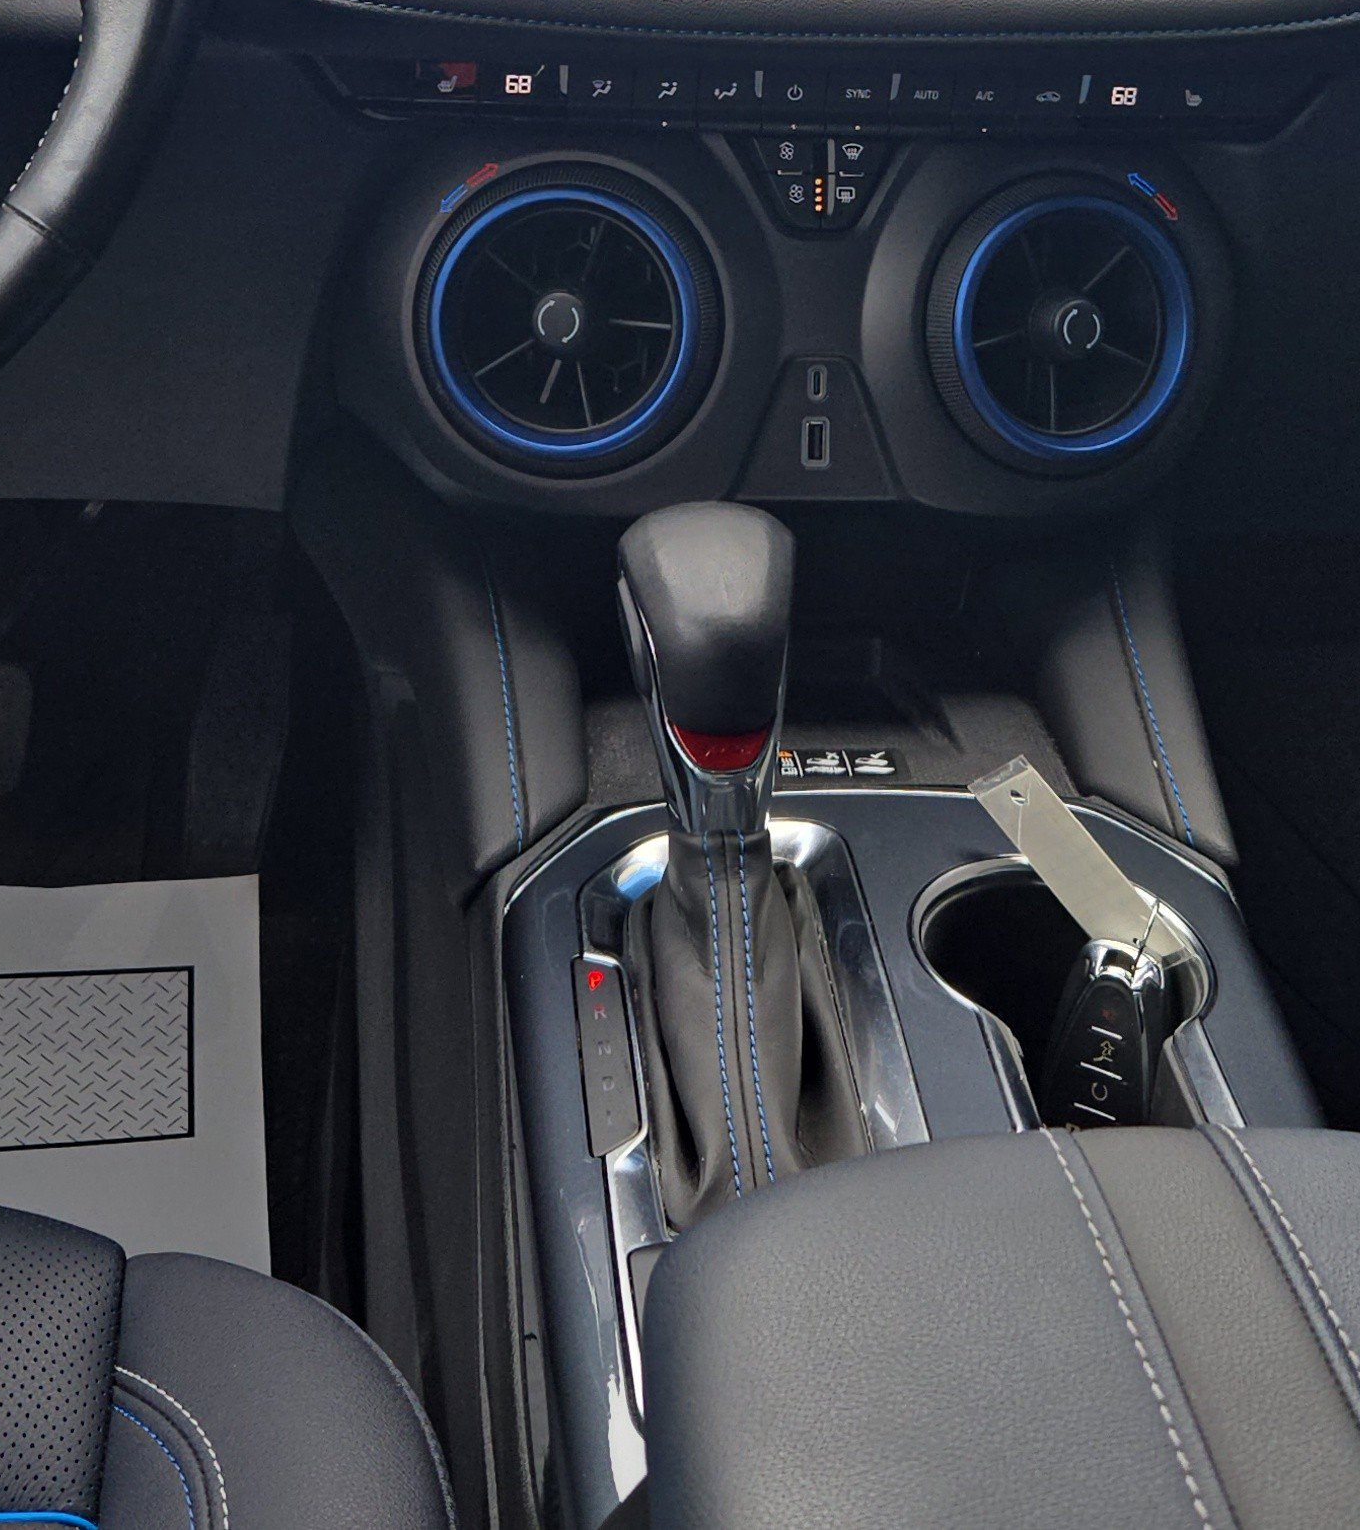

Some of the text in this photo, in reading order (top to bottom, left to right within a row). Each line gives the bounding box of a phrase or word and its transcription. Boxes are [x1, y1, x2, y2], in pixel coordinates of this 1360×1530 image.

[505, 73, 532, 95] 68
[845, 88, 871, 101] SYNC
[913, 89, 939, 101] AUTO
[975, 90, 994, 103] A/C
[1110, 85, 1138, 107] 68
[588, 970, 604, 991] P
